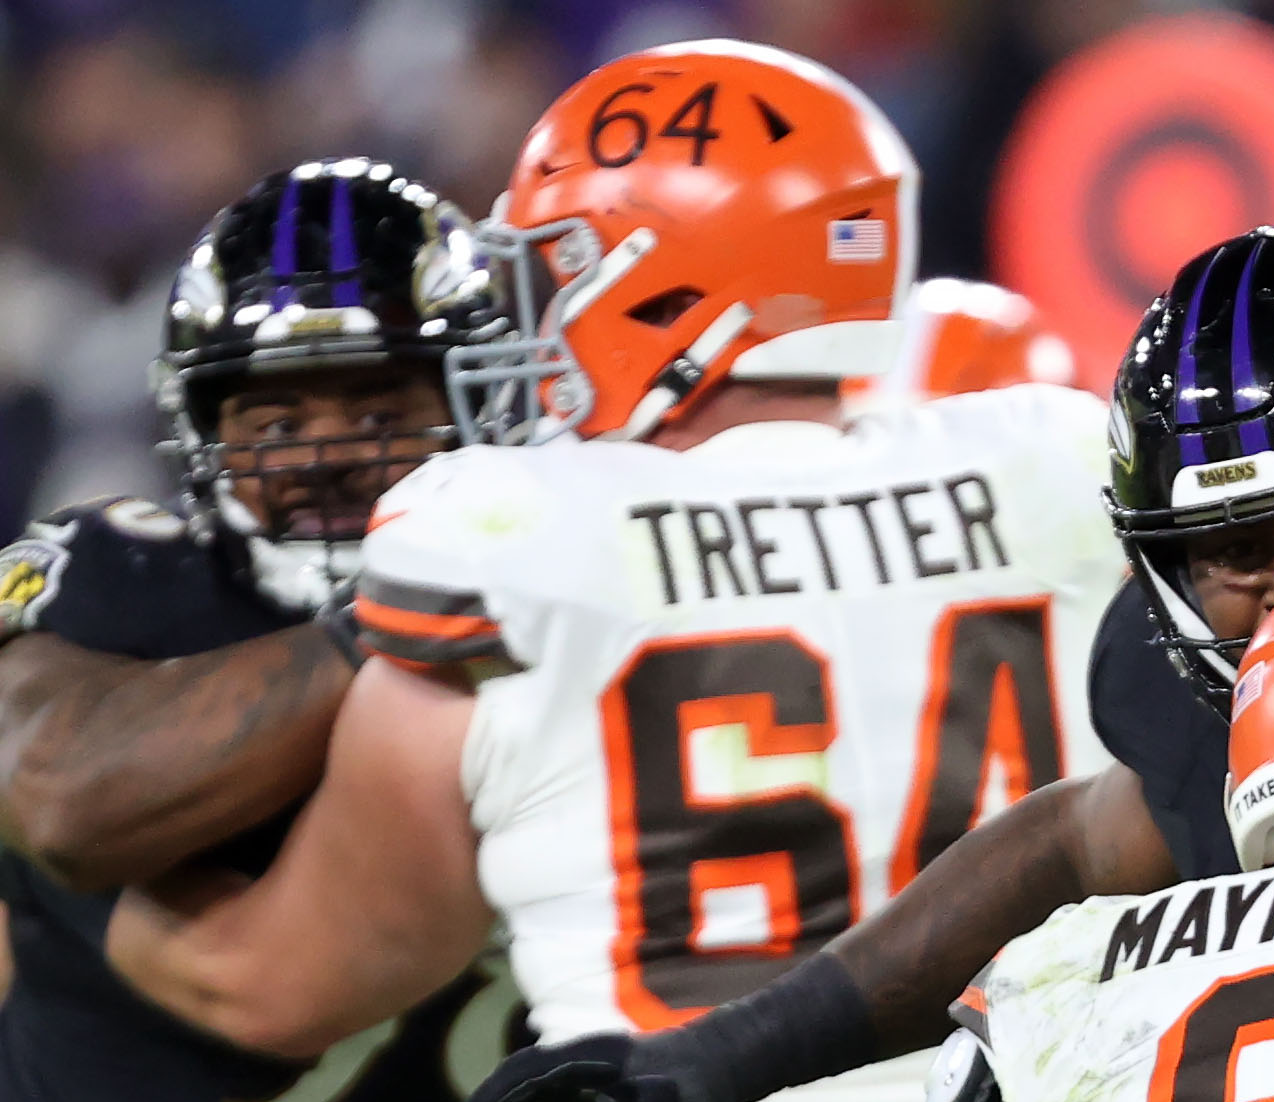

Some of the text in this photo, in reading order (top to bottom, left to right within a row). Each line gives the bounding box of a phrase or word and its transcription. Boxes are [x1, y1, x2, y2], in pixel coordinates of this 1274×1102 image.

[588, 81, 722, 169] 64
[1195, 461, 1258, 488] RAVENS
[629, 469, 1012, 606] TRETTER
[597, 593, 1069, 1034] 64
